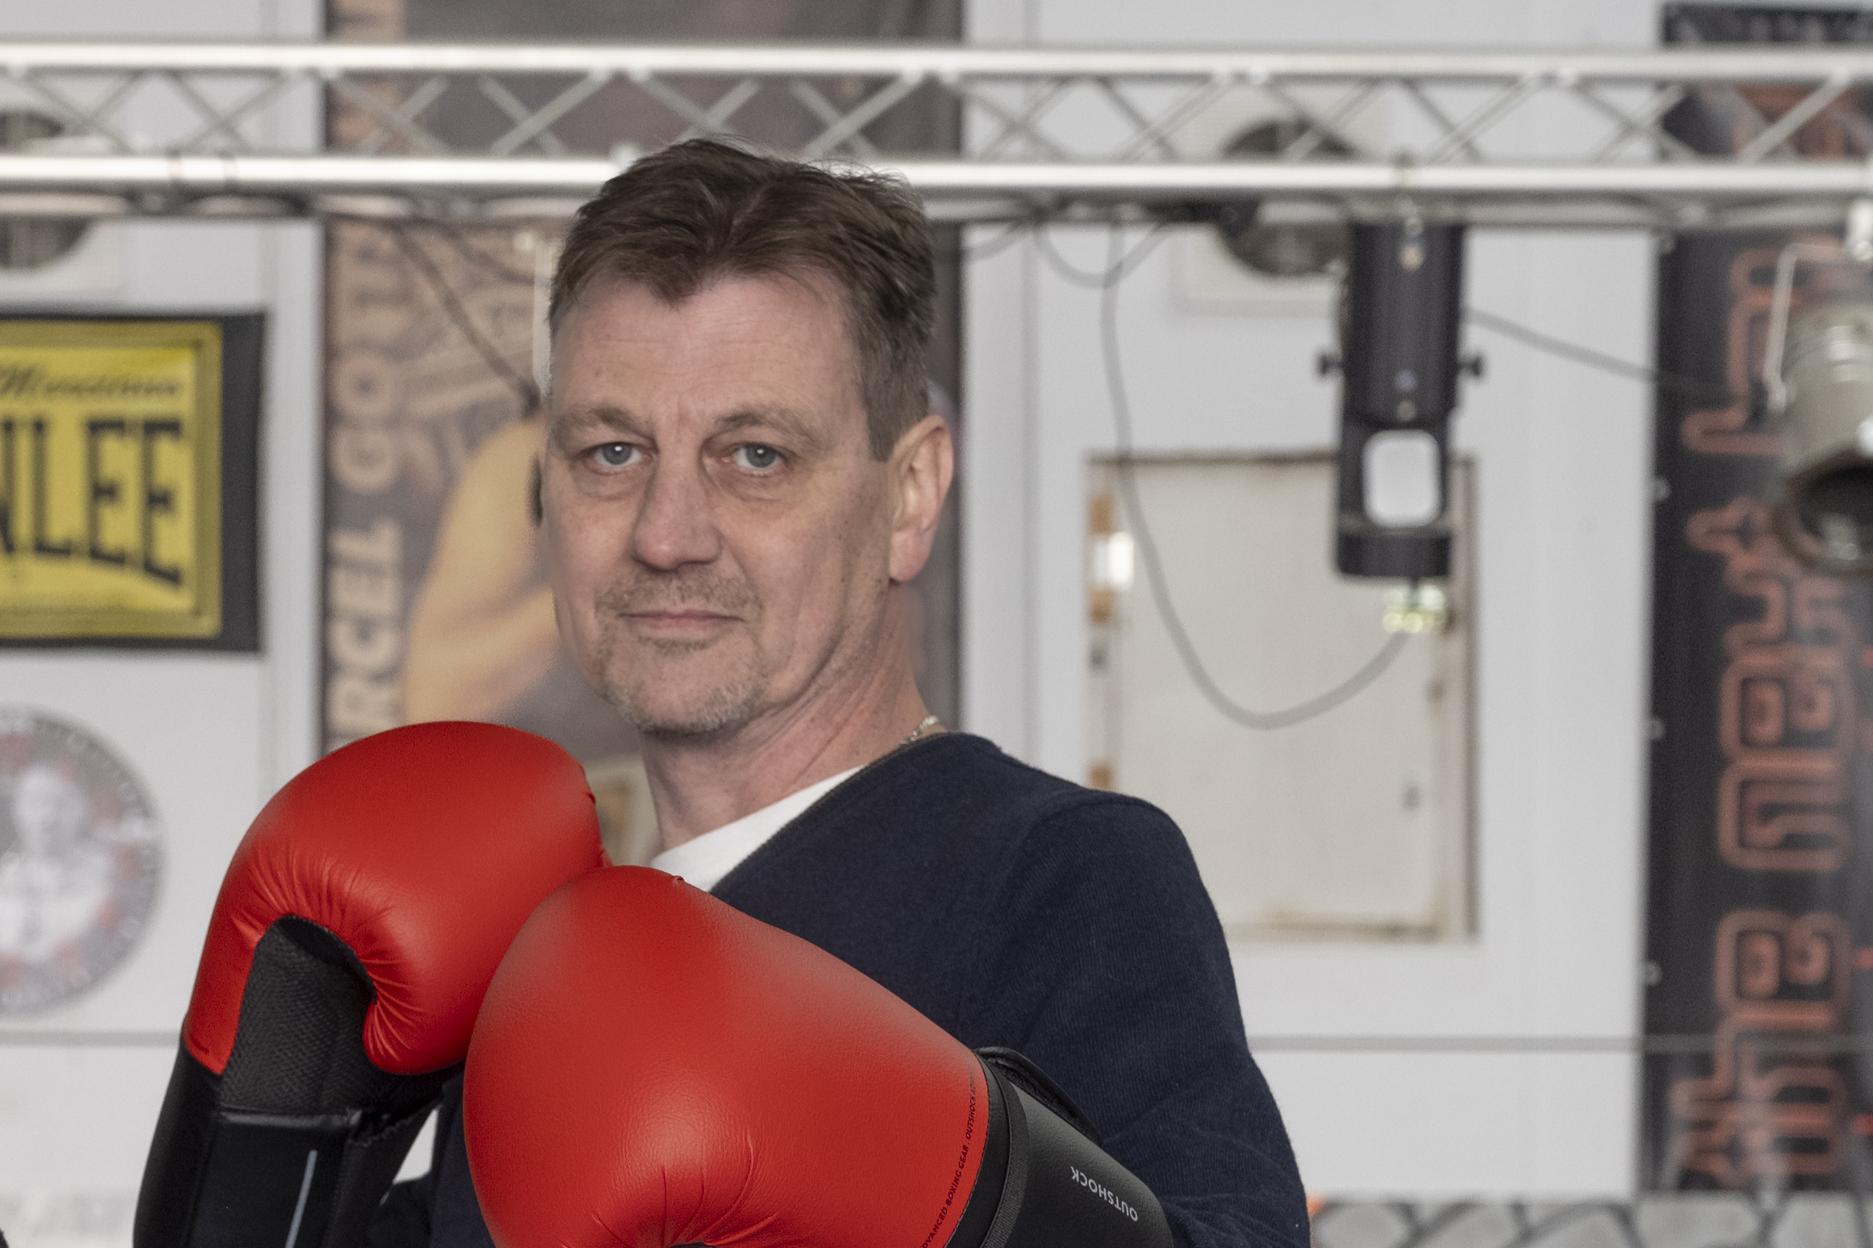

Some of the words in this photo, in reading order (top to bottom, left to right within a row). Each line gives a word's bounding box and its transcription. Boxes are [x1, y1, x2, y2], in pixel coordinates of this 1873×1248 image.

[331, 518, 403, 740] RCEL
[945, 1169, 963, 1207] BOXING
[957, 1144, 970, 1170] GEAR
[964, 1094, 976, 1140] OUTSHOCK
[1069, 1165, 1139, 1222] OUTSHOCK
